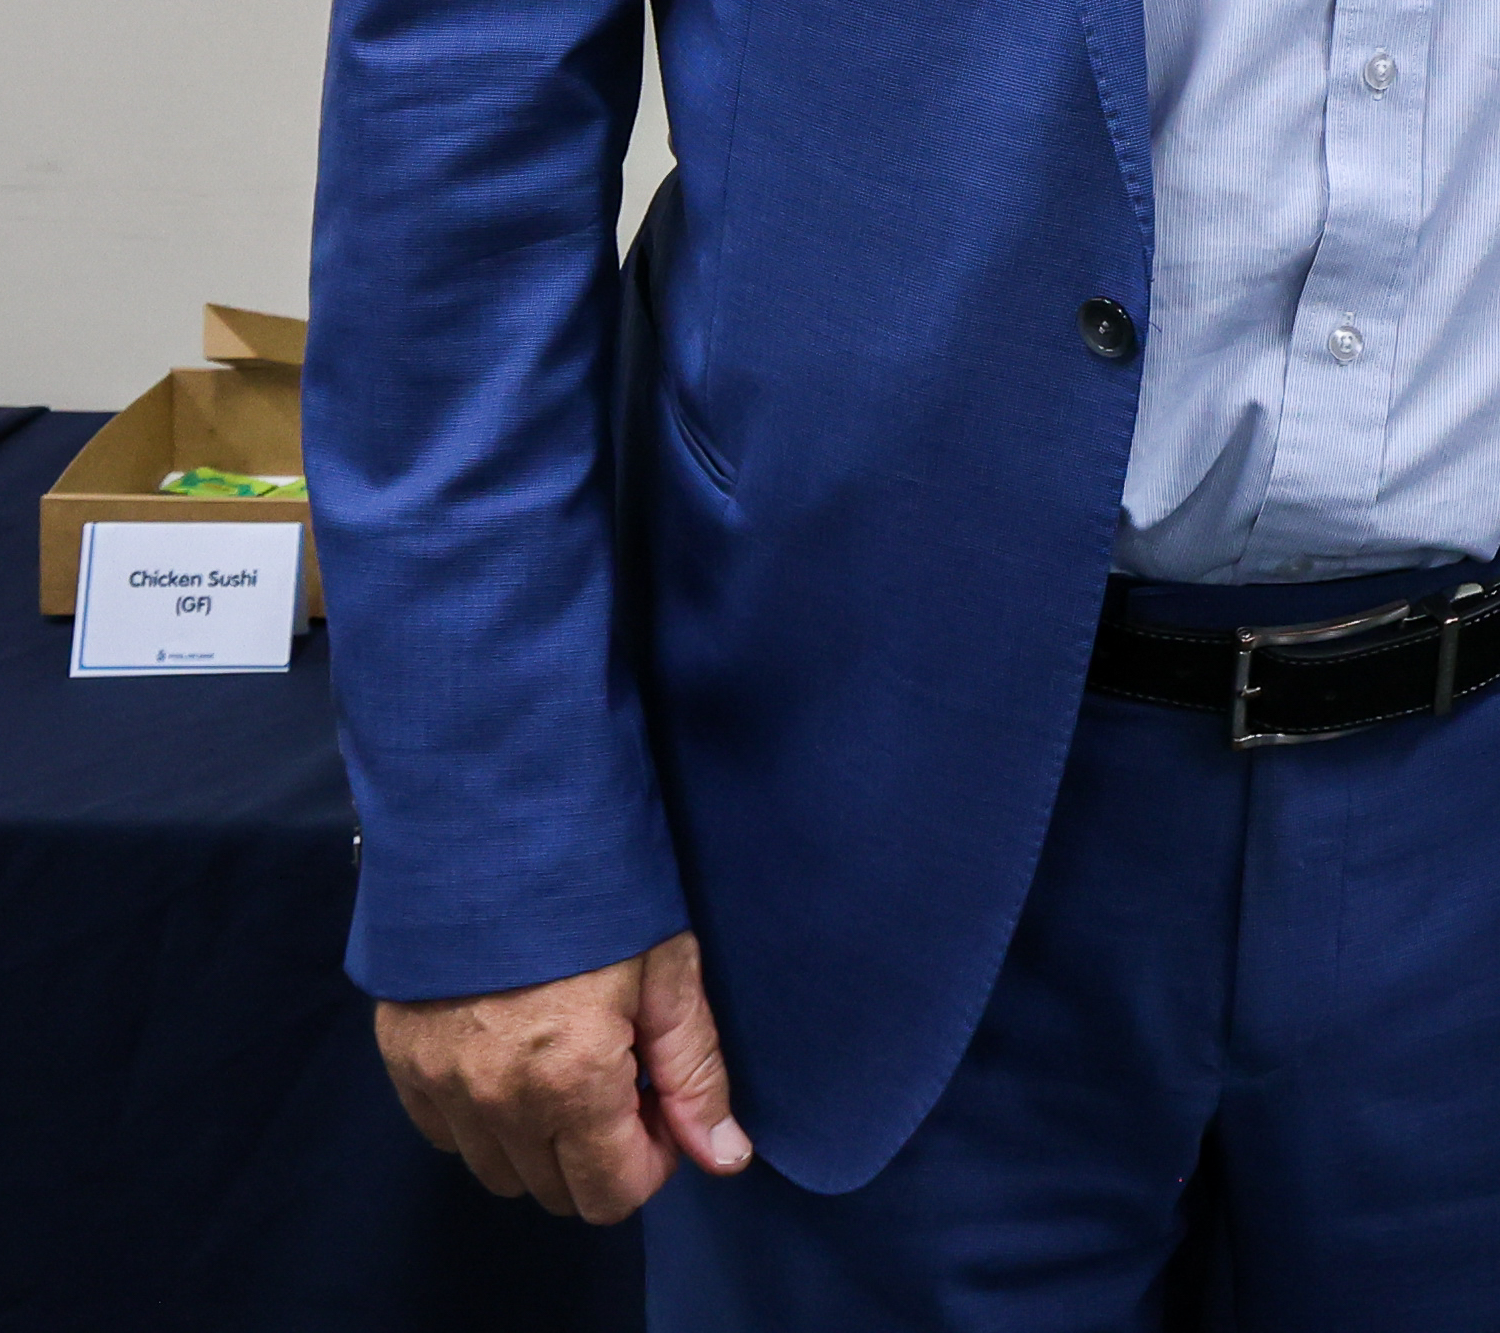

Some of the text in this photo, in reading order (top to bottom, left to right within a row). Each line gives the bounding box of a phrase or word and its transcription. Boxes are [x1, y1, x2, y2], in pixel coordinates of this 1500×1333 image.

[129, 569, 258, 588] Chicken Sushi
[175, 596, 212, 616] (GF)
